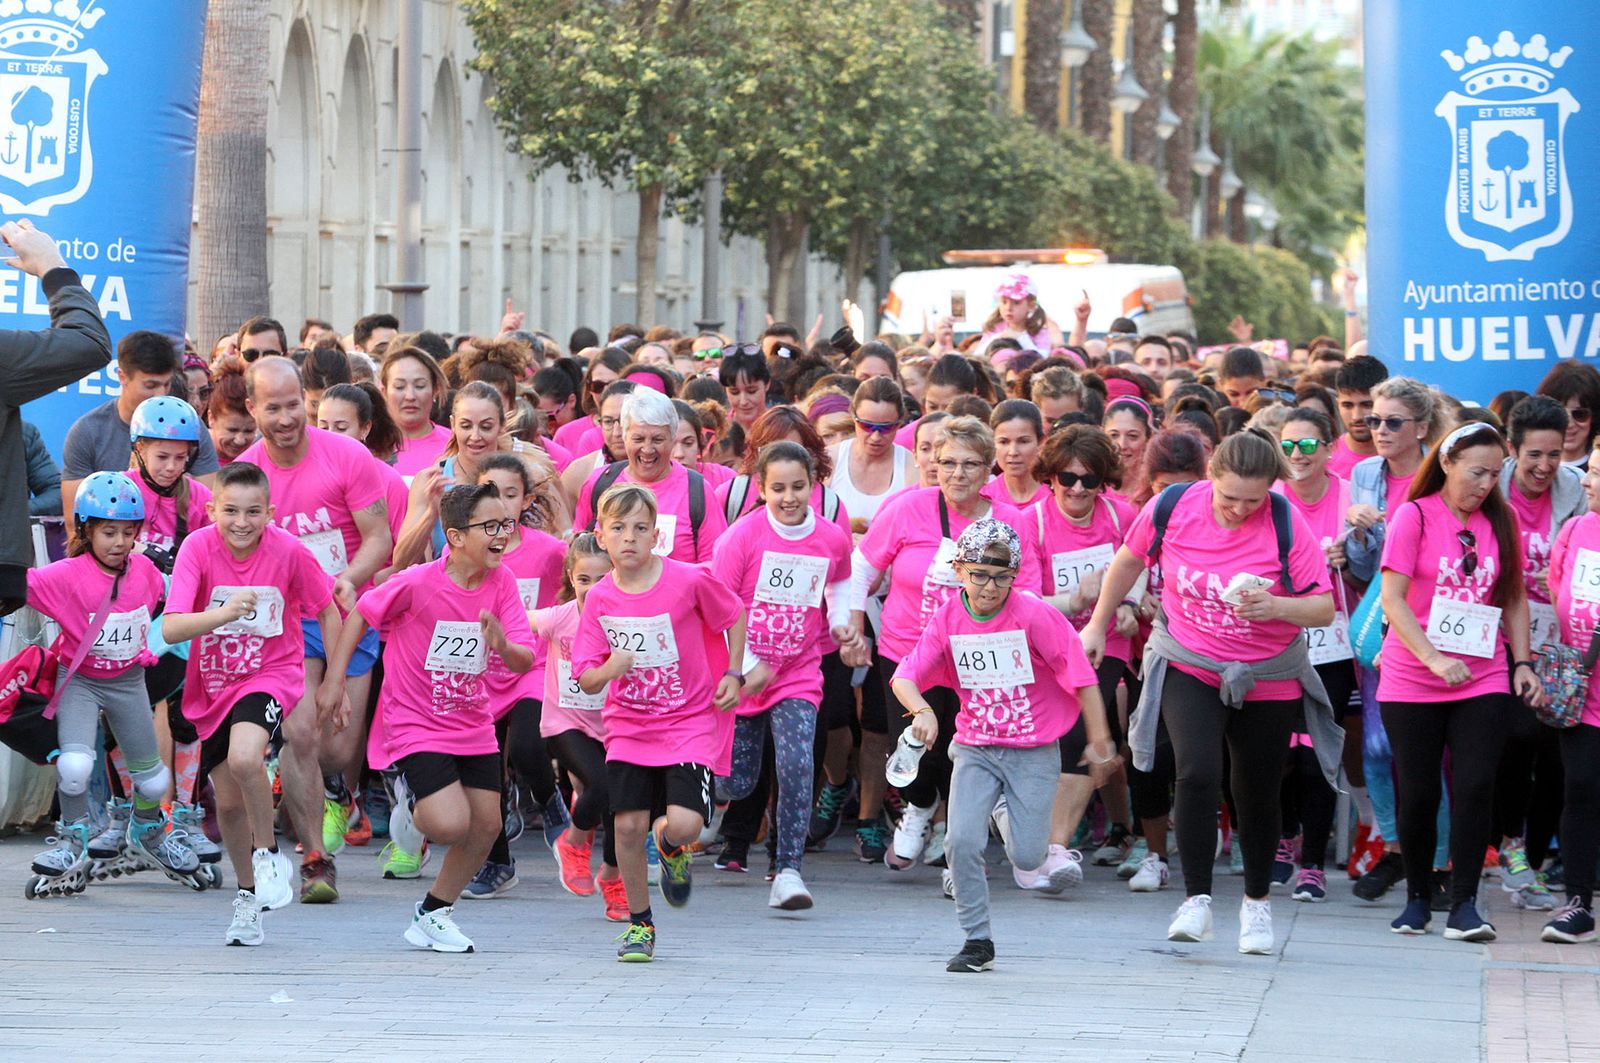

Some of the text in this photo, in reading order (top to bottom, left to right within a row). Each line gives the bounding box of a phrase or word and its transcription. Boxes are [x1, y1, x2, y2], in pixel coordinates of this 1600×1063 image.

[7, 63, 21, 73] ET
[1478, 108, 1494, 118] ET
[68, 98, 80, 155] CUSTODIA
[1459, 128, 1470, 214] PORTUS MARIS
[1546, 139, 1556, 196] CUSTODIA
[57, 237, 137, 263] nto de
[1403, 278, 1585, 310] Ayuntamiento
[281, 506, 333, 537] M
[769, 567, 794, 589] 86
[748, 608, 806, 634] POR
[1439, 614, 1465, 636] 66
[1530, 618, 1539, 634] 4
[94, 625, 133, 647] 244
[200, 634, 265, 660] POR
[434, 635, 478, 658] 722
[607, 630, 647, 654] 322
[199, 654, 263, 675] ELLAS
[958, 650, 998, 671] 481
